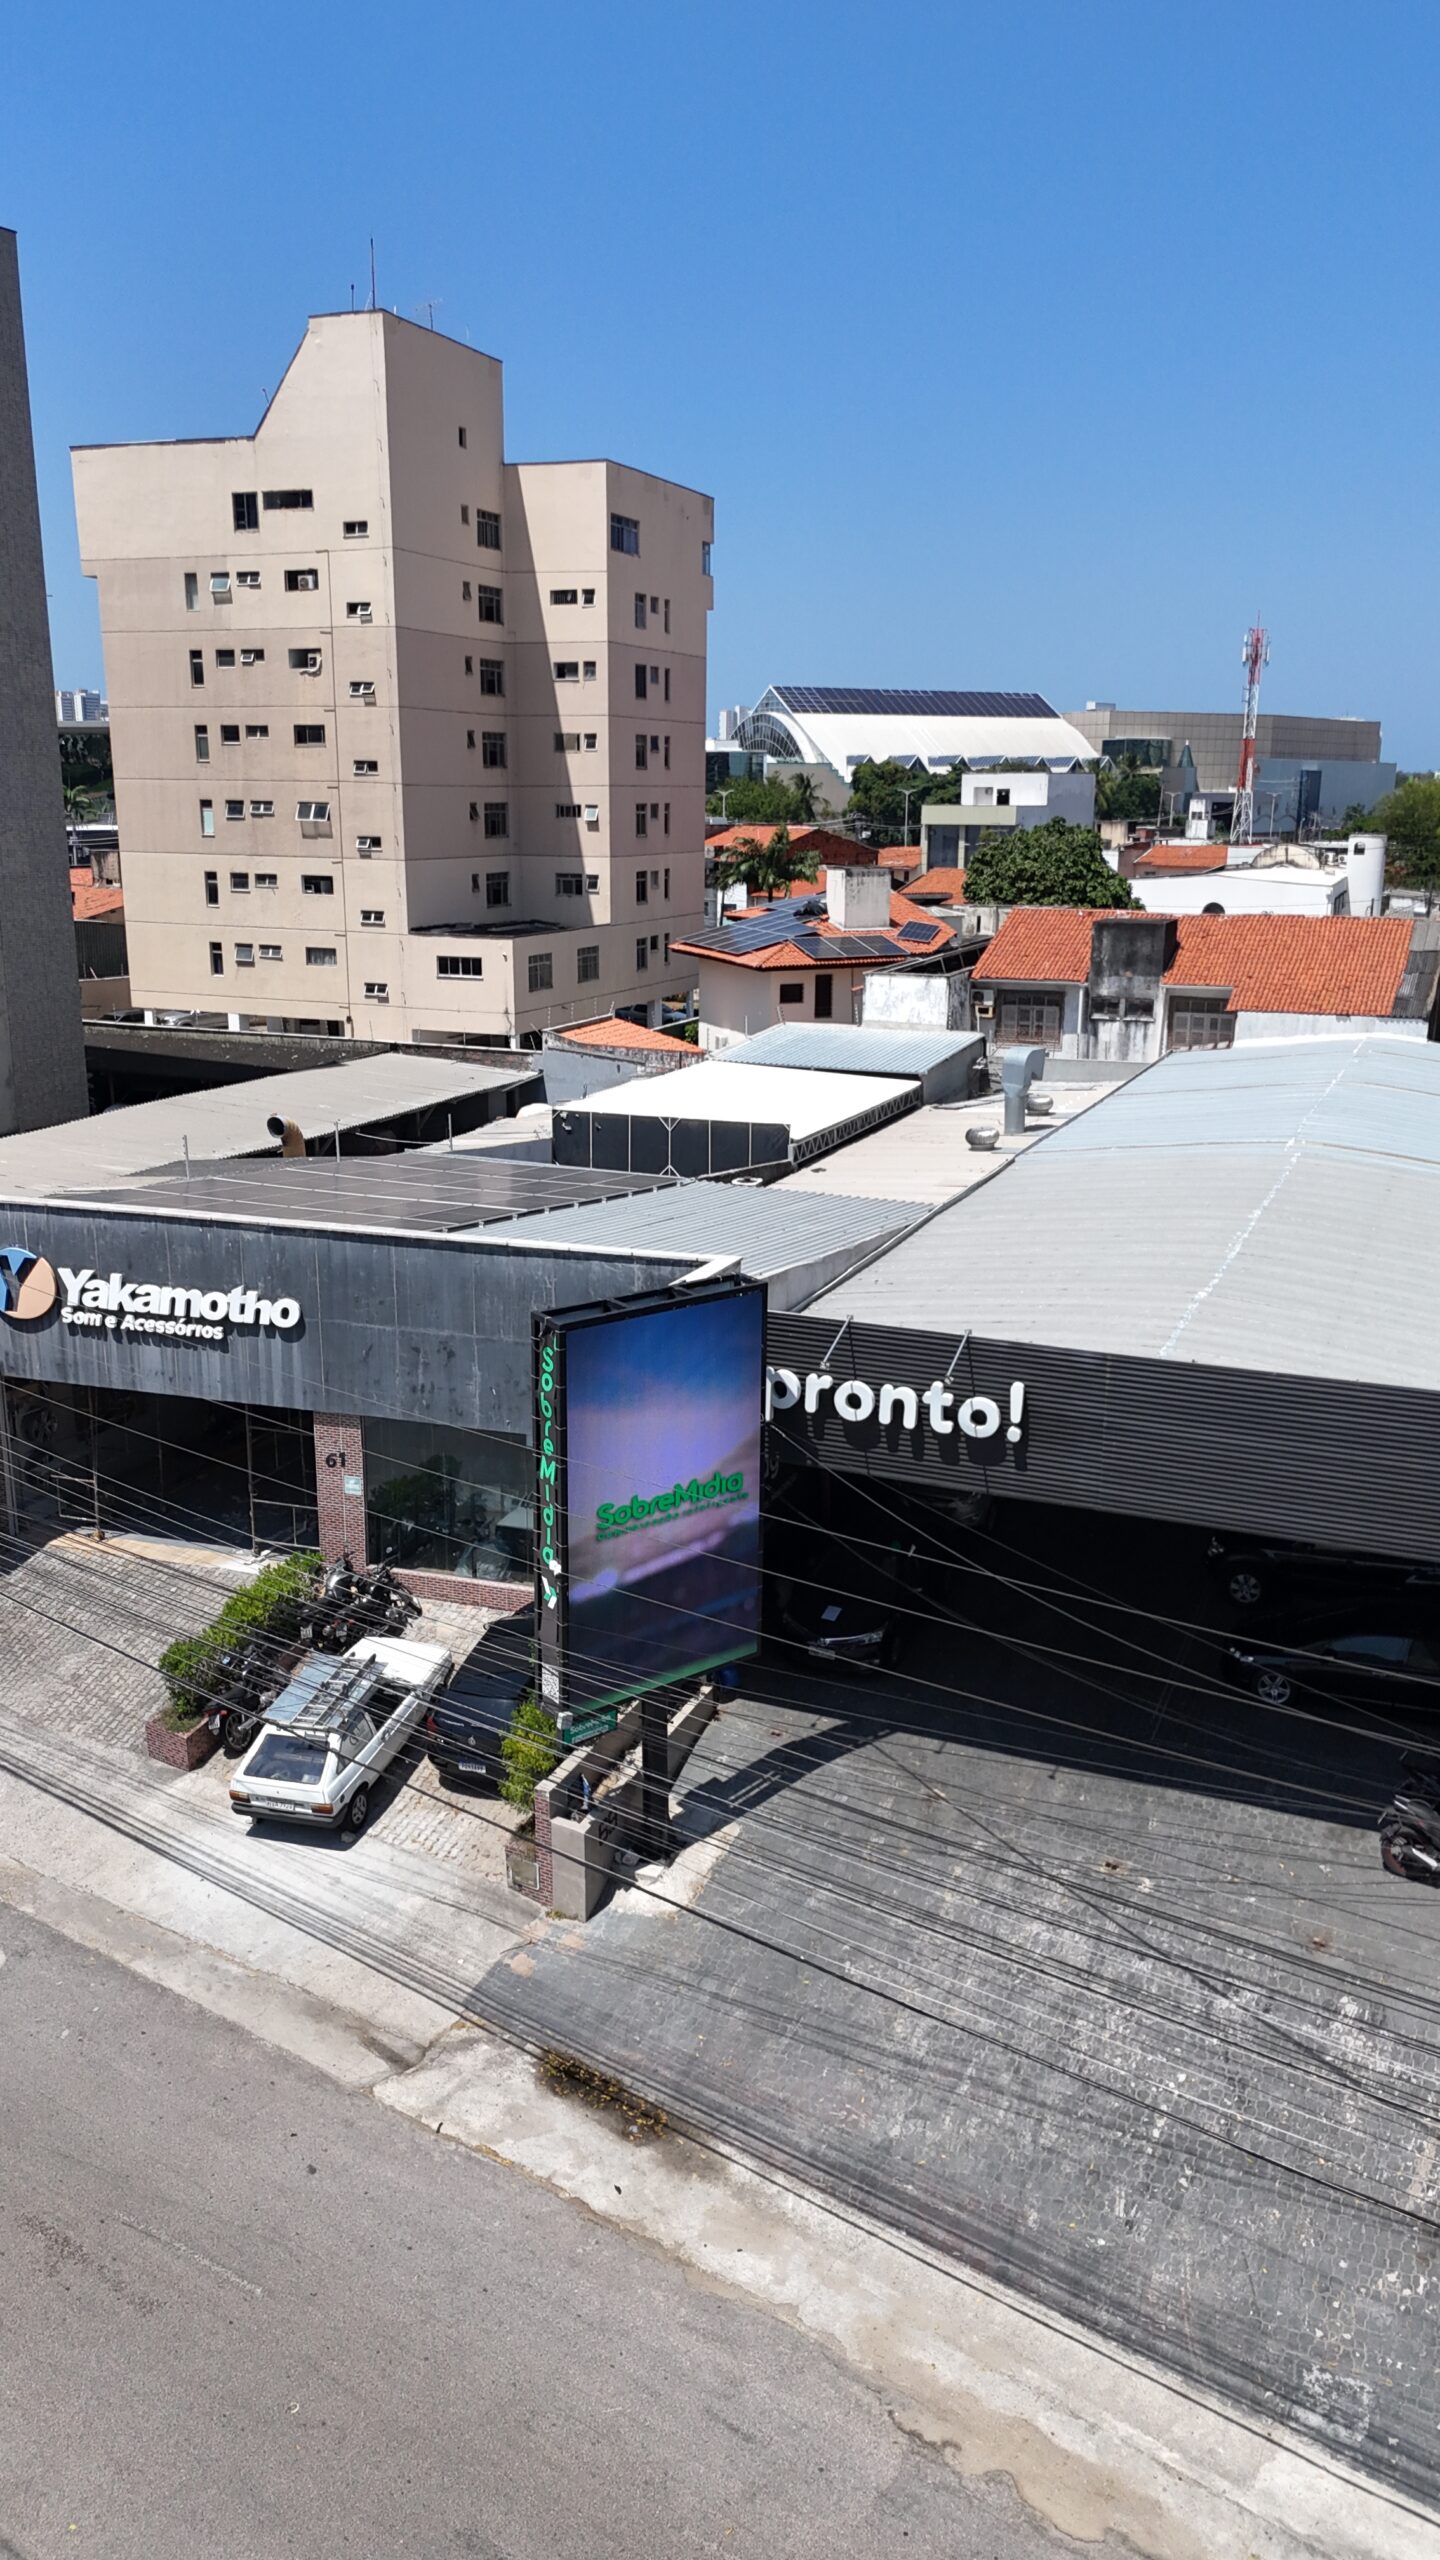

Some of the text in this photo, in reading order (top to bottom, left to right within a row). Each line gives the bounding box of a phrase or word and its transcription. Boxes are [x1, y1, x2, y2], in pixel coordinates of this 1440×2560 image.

[57, 1267, 301, 1329] Yakamotho
[61, 1307, 224, 1341] Som e Acessórios
[766, 1366, 1025, 1444] pronto!
[325, 1451, 347, 1468] 61
